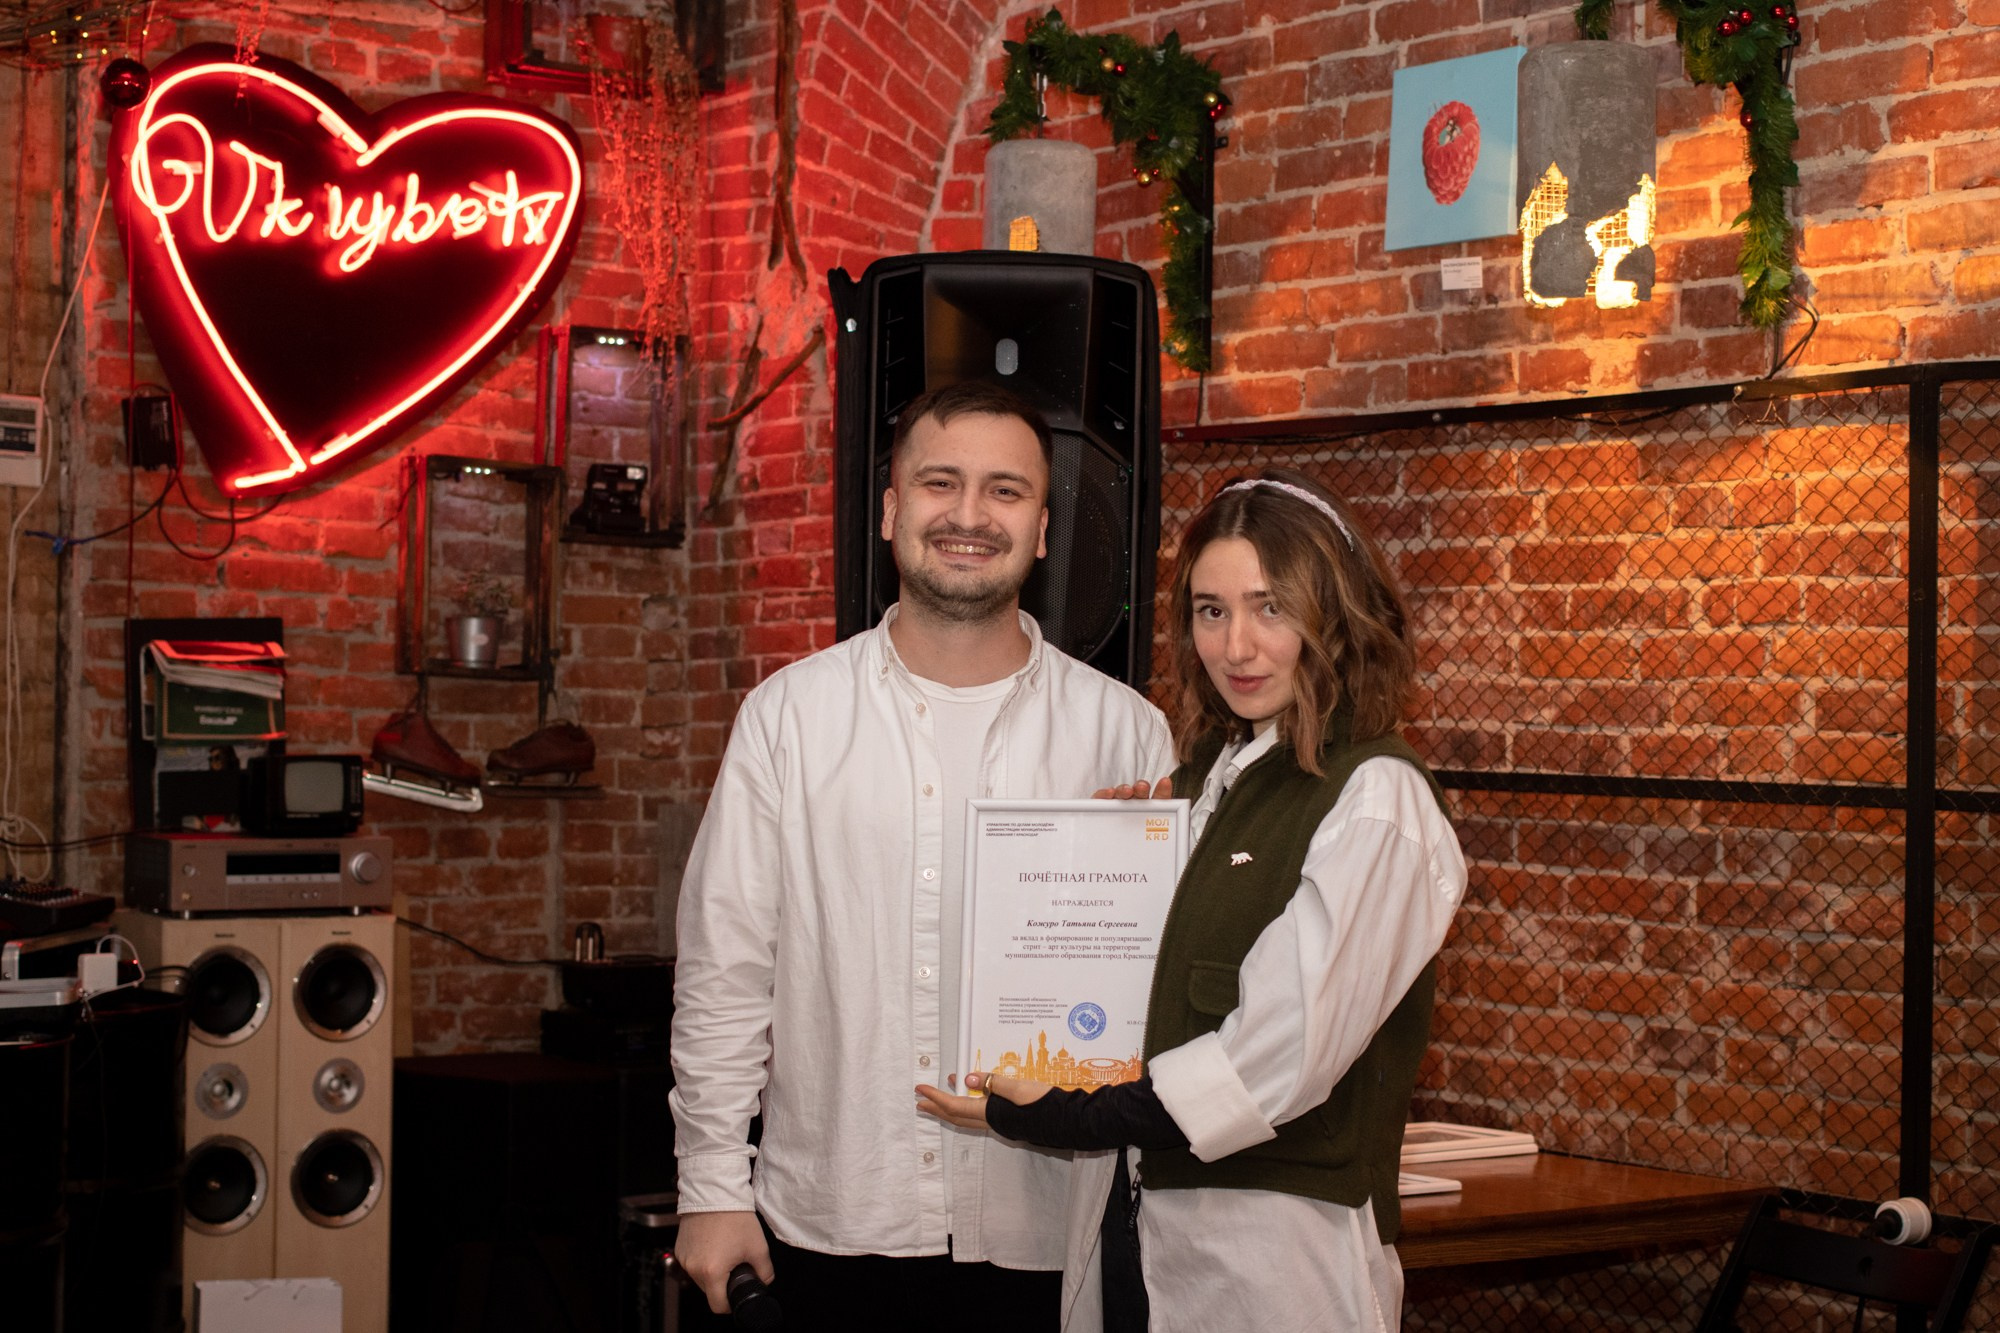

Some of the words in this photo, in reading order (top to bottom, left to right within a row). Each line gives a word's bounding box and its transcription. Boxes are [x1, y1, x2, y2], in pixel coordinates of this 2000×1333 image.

[1019, 871, 1085, 882] ПОЧЁТНАЯ
[1089, 872, 1148, 883] ГРАМОТА
[1026, 920, 1059, 928] Кожуро
[1062, 920, 1096, 928] Татьяна
[1098, 920, 1138, 928] Сергеевна
